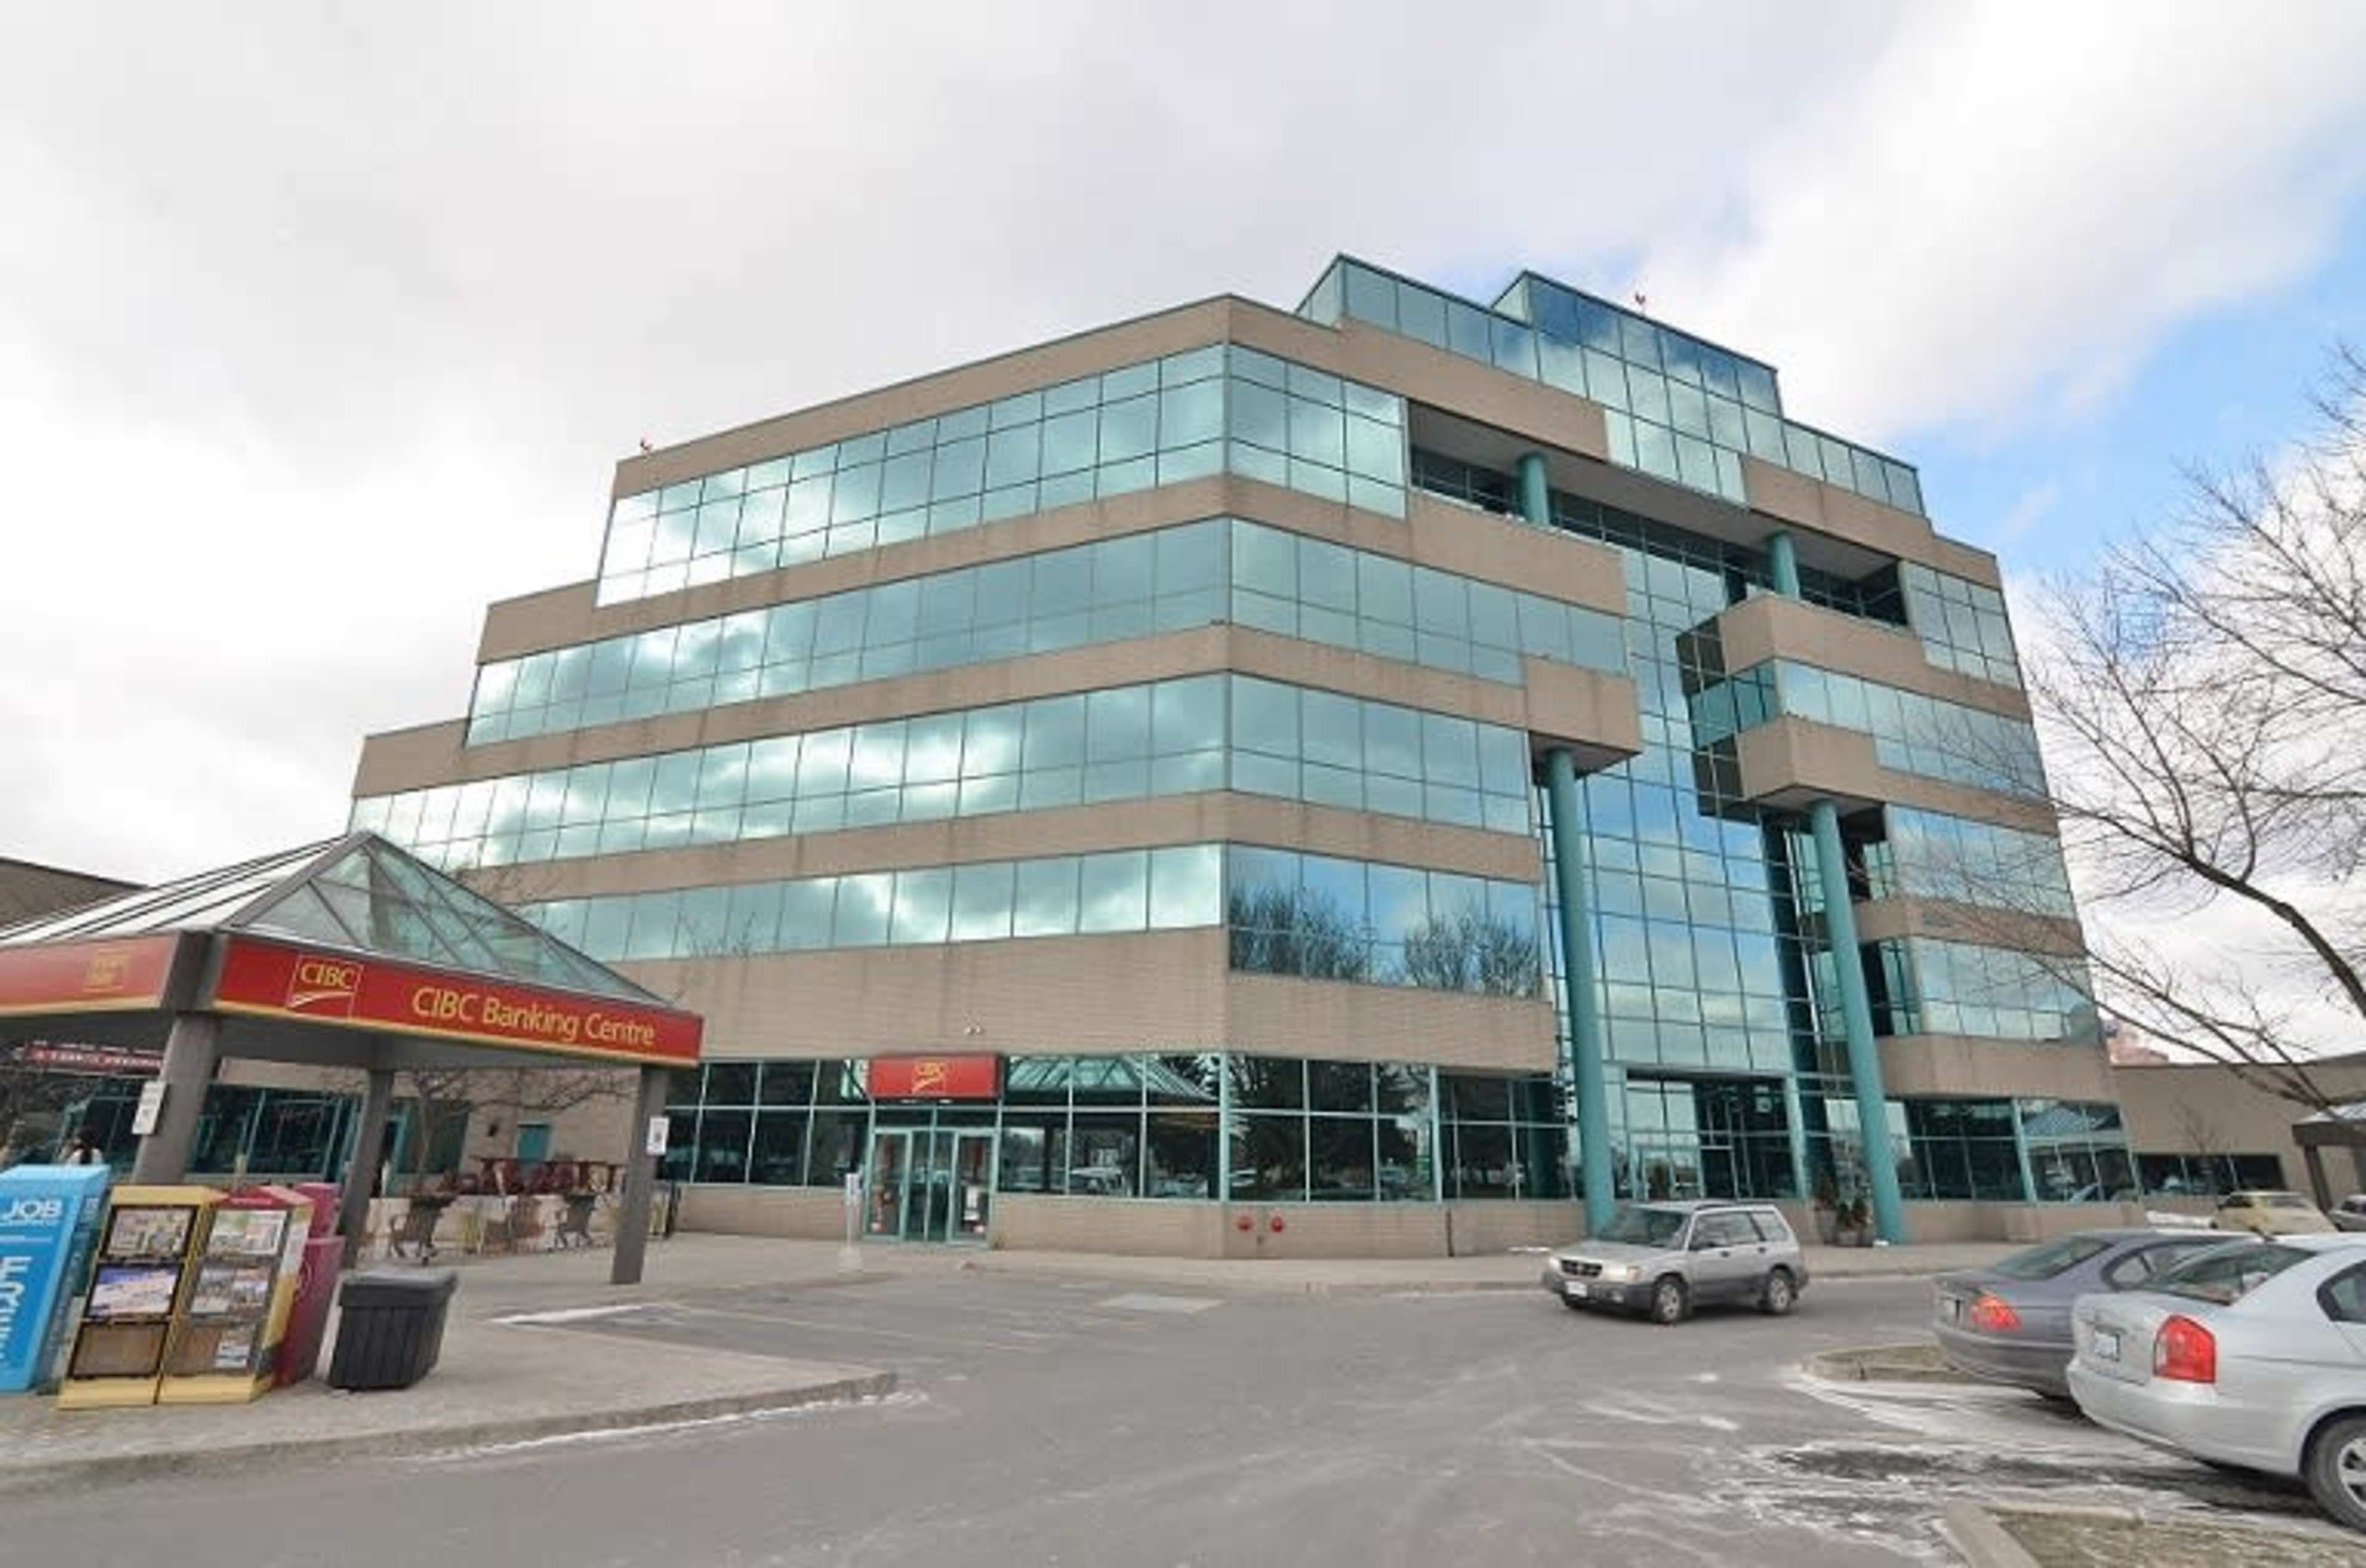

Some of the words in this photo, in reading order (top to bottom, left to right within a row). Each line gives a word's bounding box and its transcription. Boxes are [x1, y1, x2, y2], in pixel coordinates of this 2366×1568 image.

[301, 962, 356, 990] CIBC
[412, 986, 479, 1023] CIBC
[482, 997, 579, 1042] Banking
[585, 1012, 655, 1046] Centre
[2, 1197, 62, 1219] JOB
